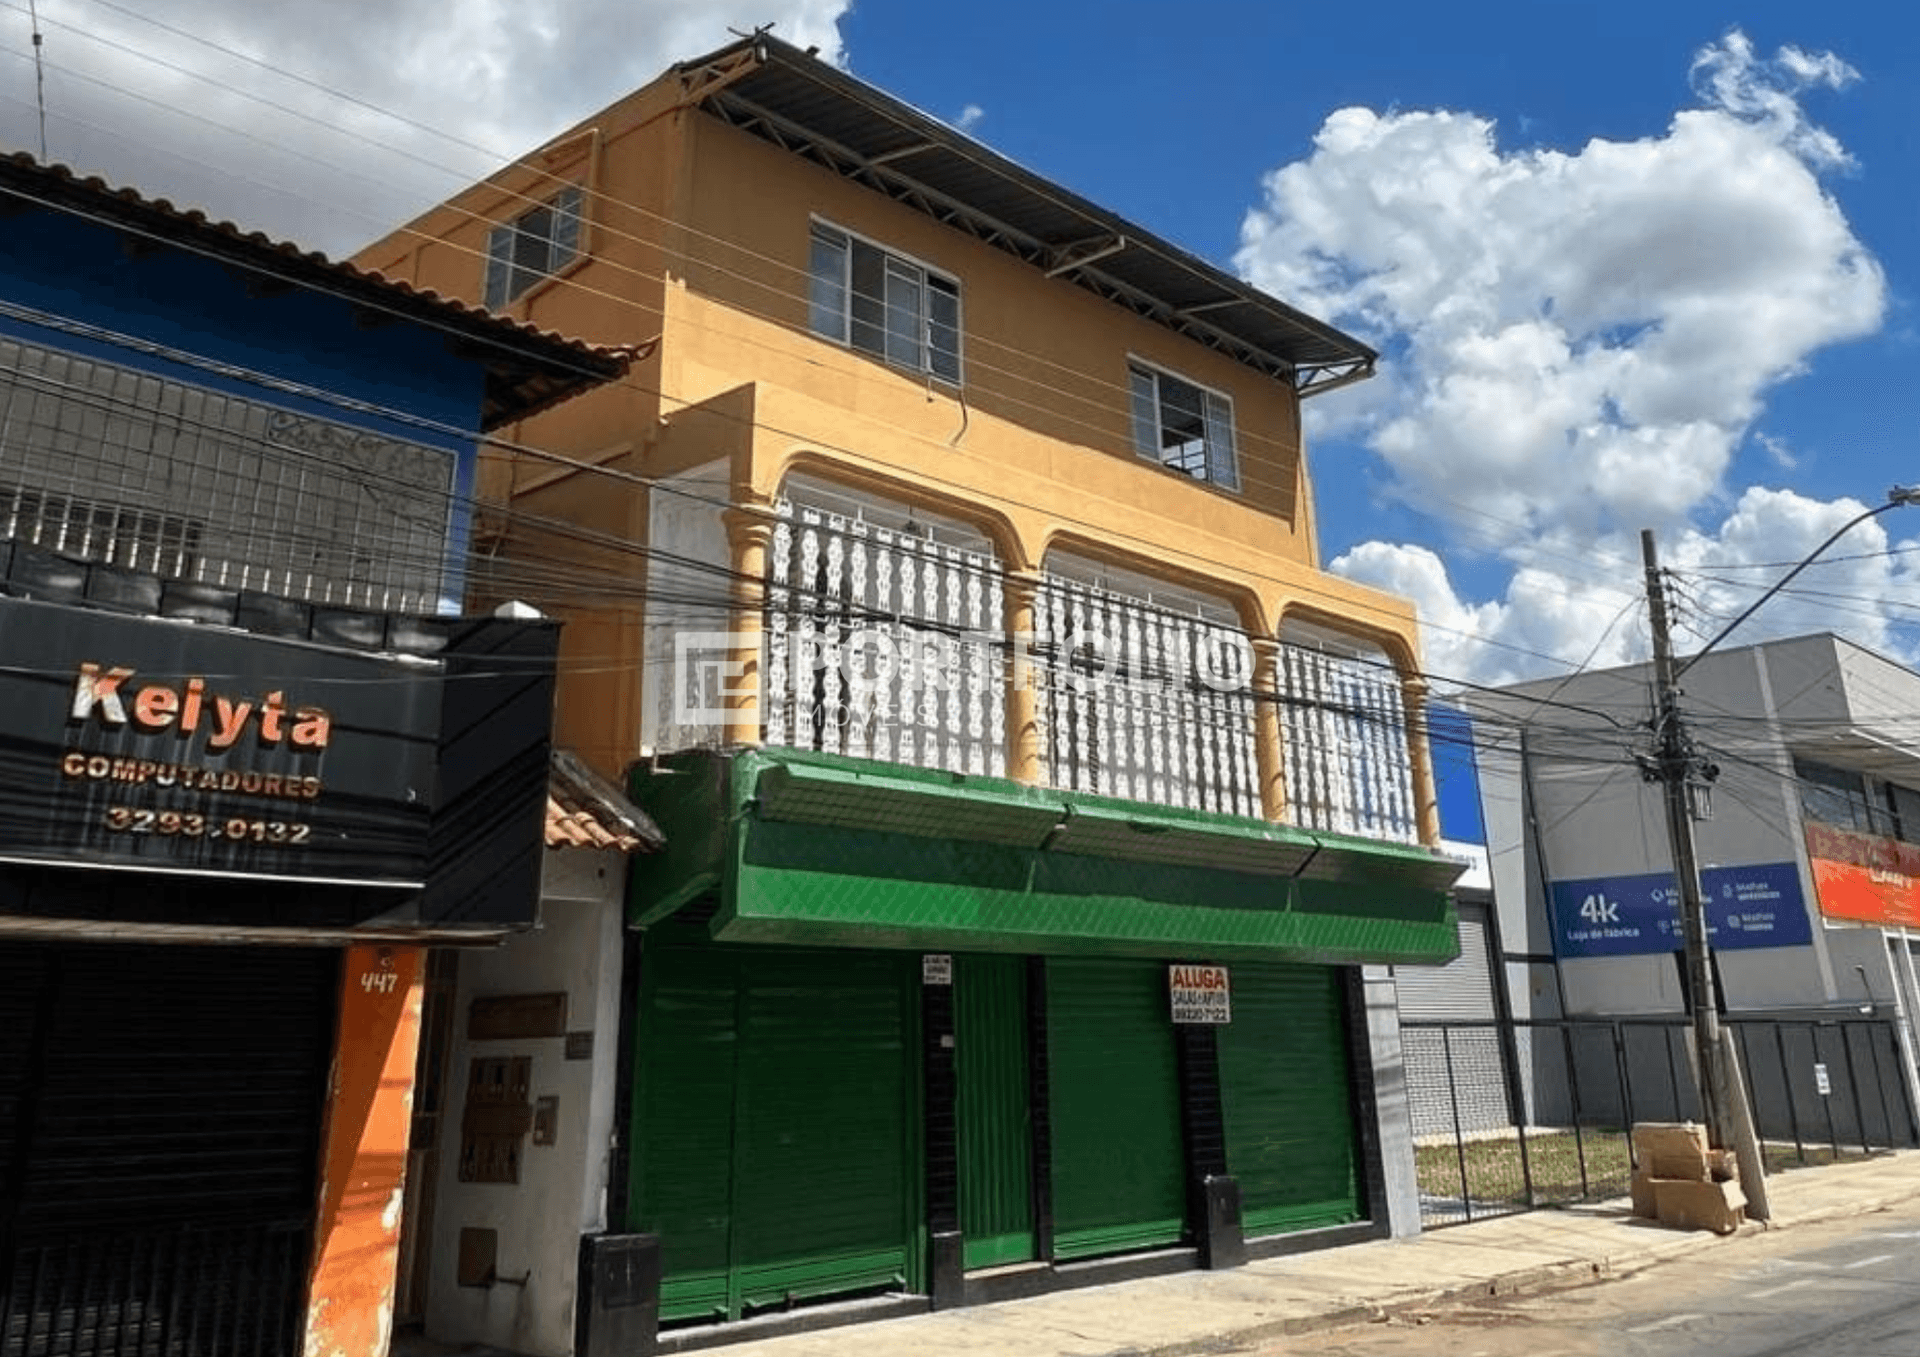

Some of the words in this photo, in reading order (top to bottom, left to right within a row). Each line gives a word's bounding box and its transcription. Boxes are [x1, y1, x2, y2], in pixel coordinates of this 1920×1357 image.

[63, 753, 320, 798] COMPUTADORES
[360, 971, 399, 994] 447
[1173, 967, 1226, 989] ALUGA
